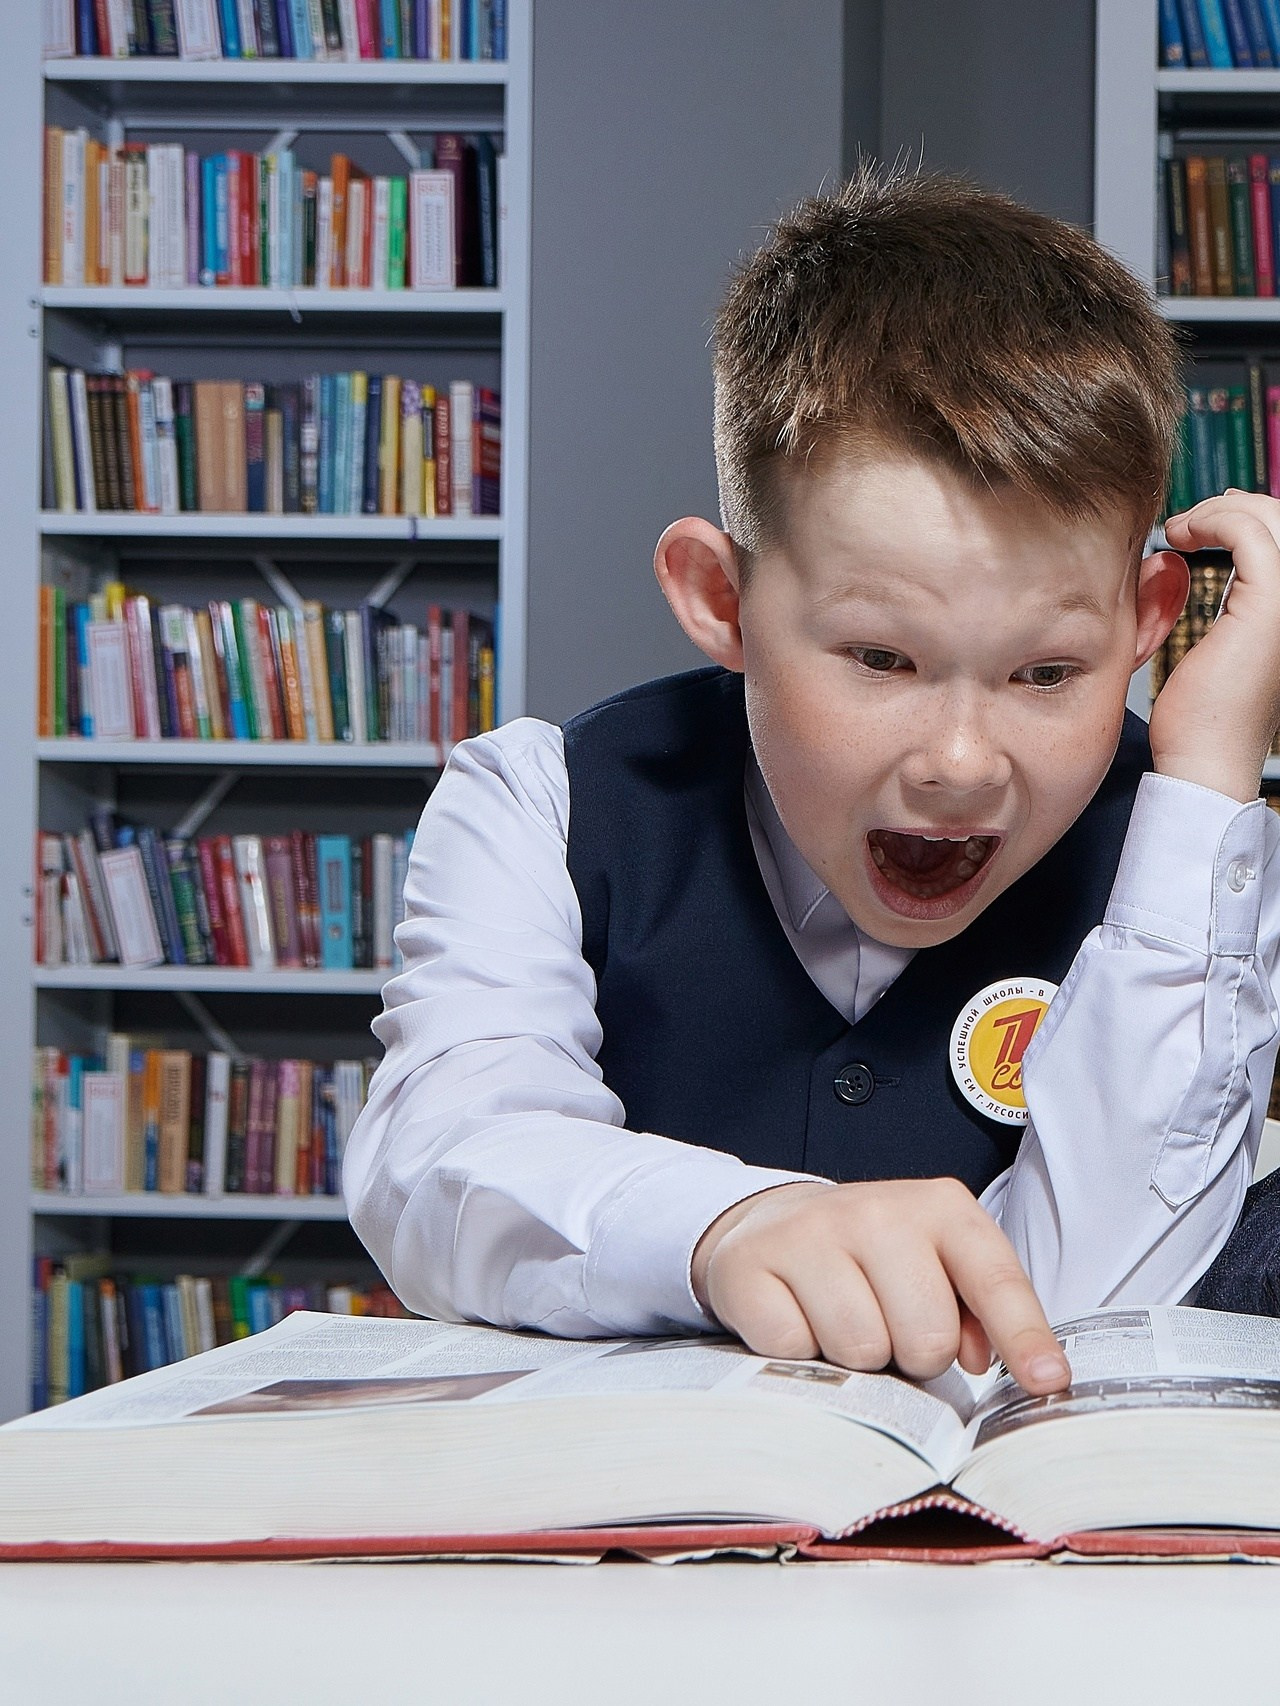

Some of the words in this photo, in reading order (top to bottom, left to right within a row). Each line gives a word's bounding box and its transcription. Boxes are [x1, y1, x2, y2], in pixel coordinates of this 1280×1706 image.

[957, 1008, 980, 1069] УСПЕШНОЙ
[982, 986, 1024, 1006] ШКОЛЫ
[1038, 989, 1045, 997] В
